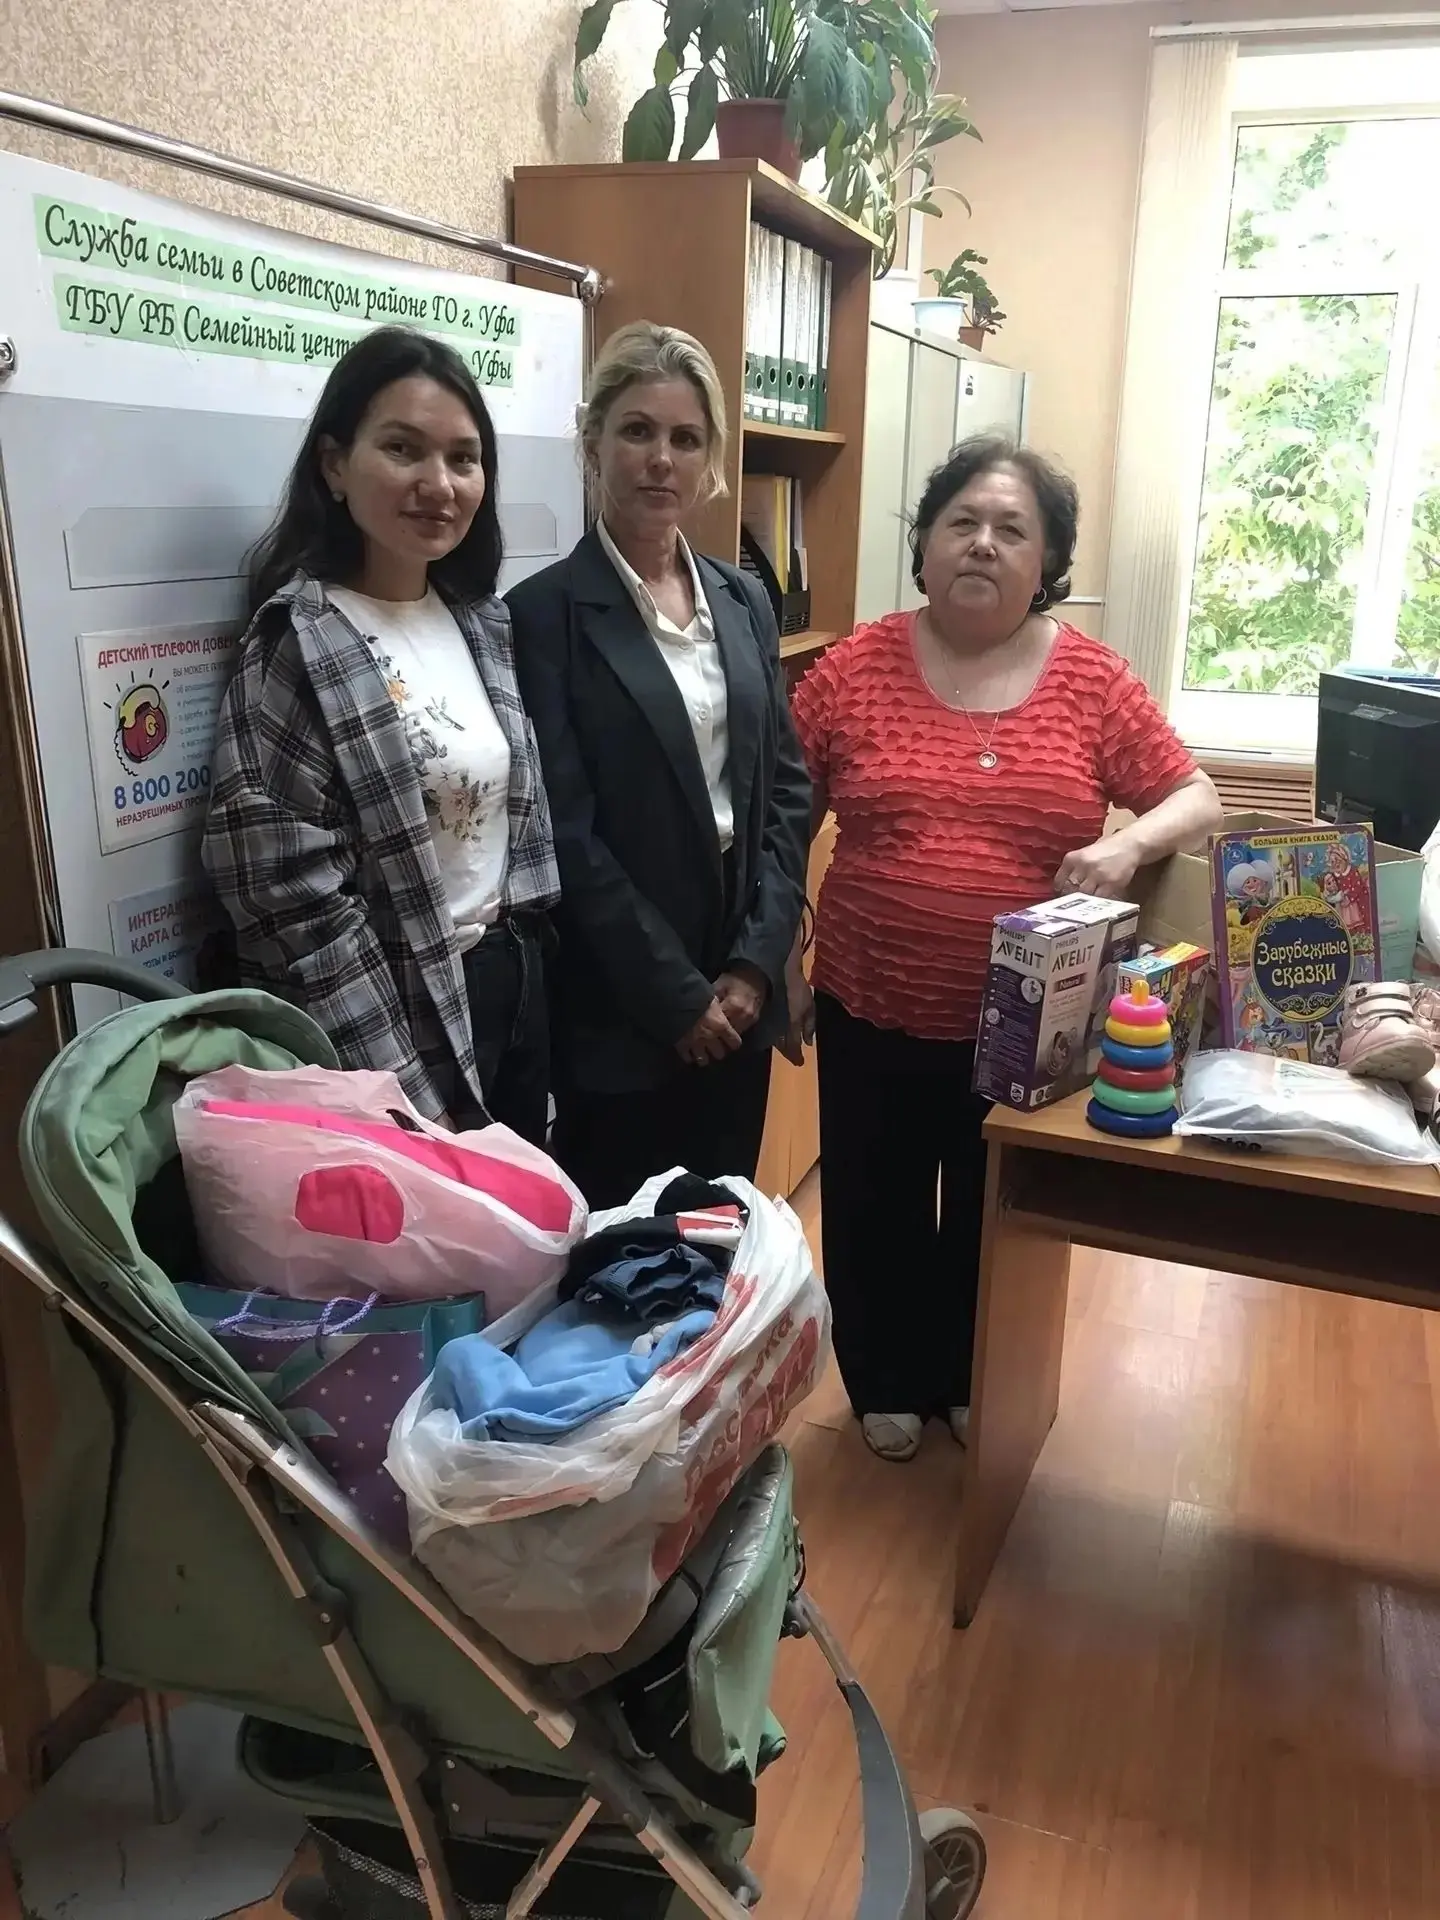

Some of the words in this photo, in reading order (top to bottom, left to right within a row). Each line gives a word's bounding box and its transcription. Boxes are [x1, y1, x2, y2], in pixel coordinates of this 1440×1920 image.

[45, 204, 149, 268] Служба
[157, 241, 224, 281] семьи
[233, 260, 243, 282] в
[251, 256, 361, 312] Советском
[364, 286, 428, 320] районе
[432, 295, 458, 324] ГО
[461, 306, 474, 329] г.
[479, 305, 516, 342] Уфа
[66, 285, 135, 334] ГБУ
[139, 299, 175, 336] РБ
[183, 305, 297, 354] Семейный
[471, 349, 513, 385] Уфы
[97, 643, 150, 669] ДЕТСКИЙ
[150, 640, 201, 659] ТЕЛЕФОН
[114, 785, 127, 809] 8
[132, 774, 171, 805] 800
[175, 764, 211, 793] 200
[116, 801, 185, 827] НЕРАЗРЕШИМЫХ
[1253, 838, 1288, 846] БОЛЬШАЯ
[1290, 835, 1312, 844] КНИГА
[1313, 832, 1338, 842] СКАЗОК
[131, 927, 170, 954] КАРТА
[999, 926, 1026, 943] PHILIPS
[1055, 936, 1080, 950] PHILIPS
[995, 940, 1045, 969] AVENT
[1051, 944, 1095, 973] AVENT
[1256, 938, 1349, 966] Зарубежные
[1272, 963, 1337, 989] сказки
